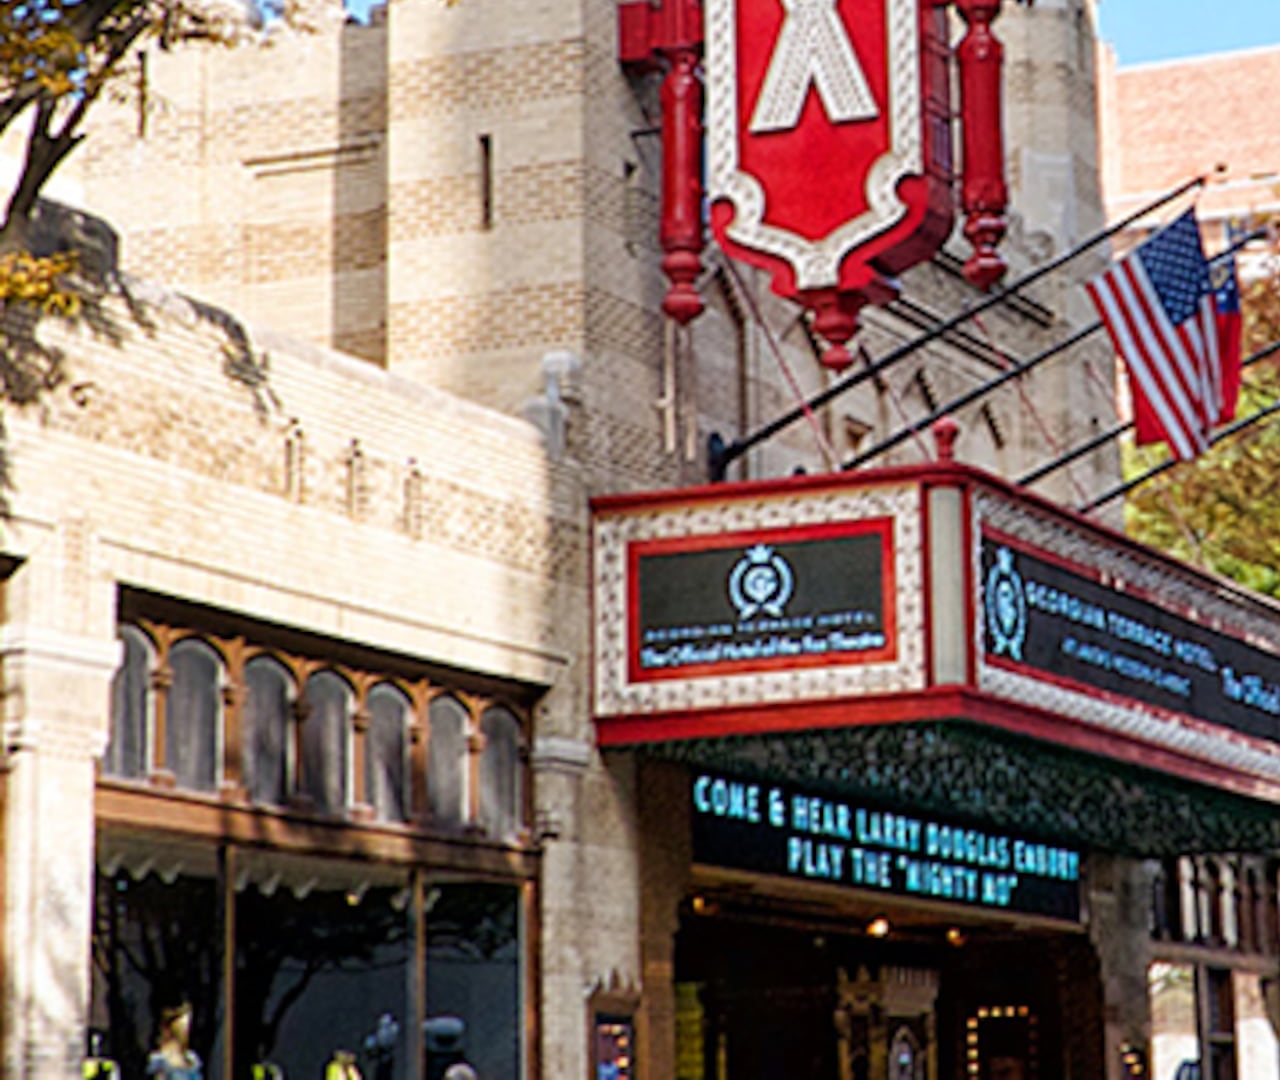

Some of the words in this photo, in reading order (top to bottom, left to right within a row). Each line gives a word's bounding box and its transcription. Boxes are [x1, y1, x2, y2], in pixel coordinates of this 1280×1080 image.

[693, 775, 761, 824] COME
[768, 787, 786, 828] &
[791, 794, 852, 841] HEAR
[855, 808, 922, 853] LARRY
[926, 821, 1011, 869] DOUGLAS
[786, 836, 844, 880] PLAY
[849, 846, 892, 889] THE
[896, 854, 979, 902] "MIGHTY
